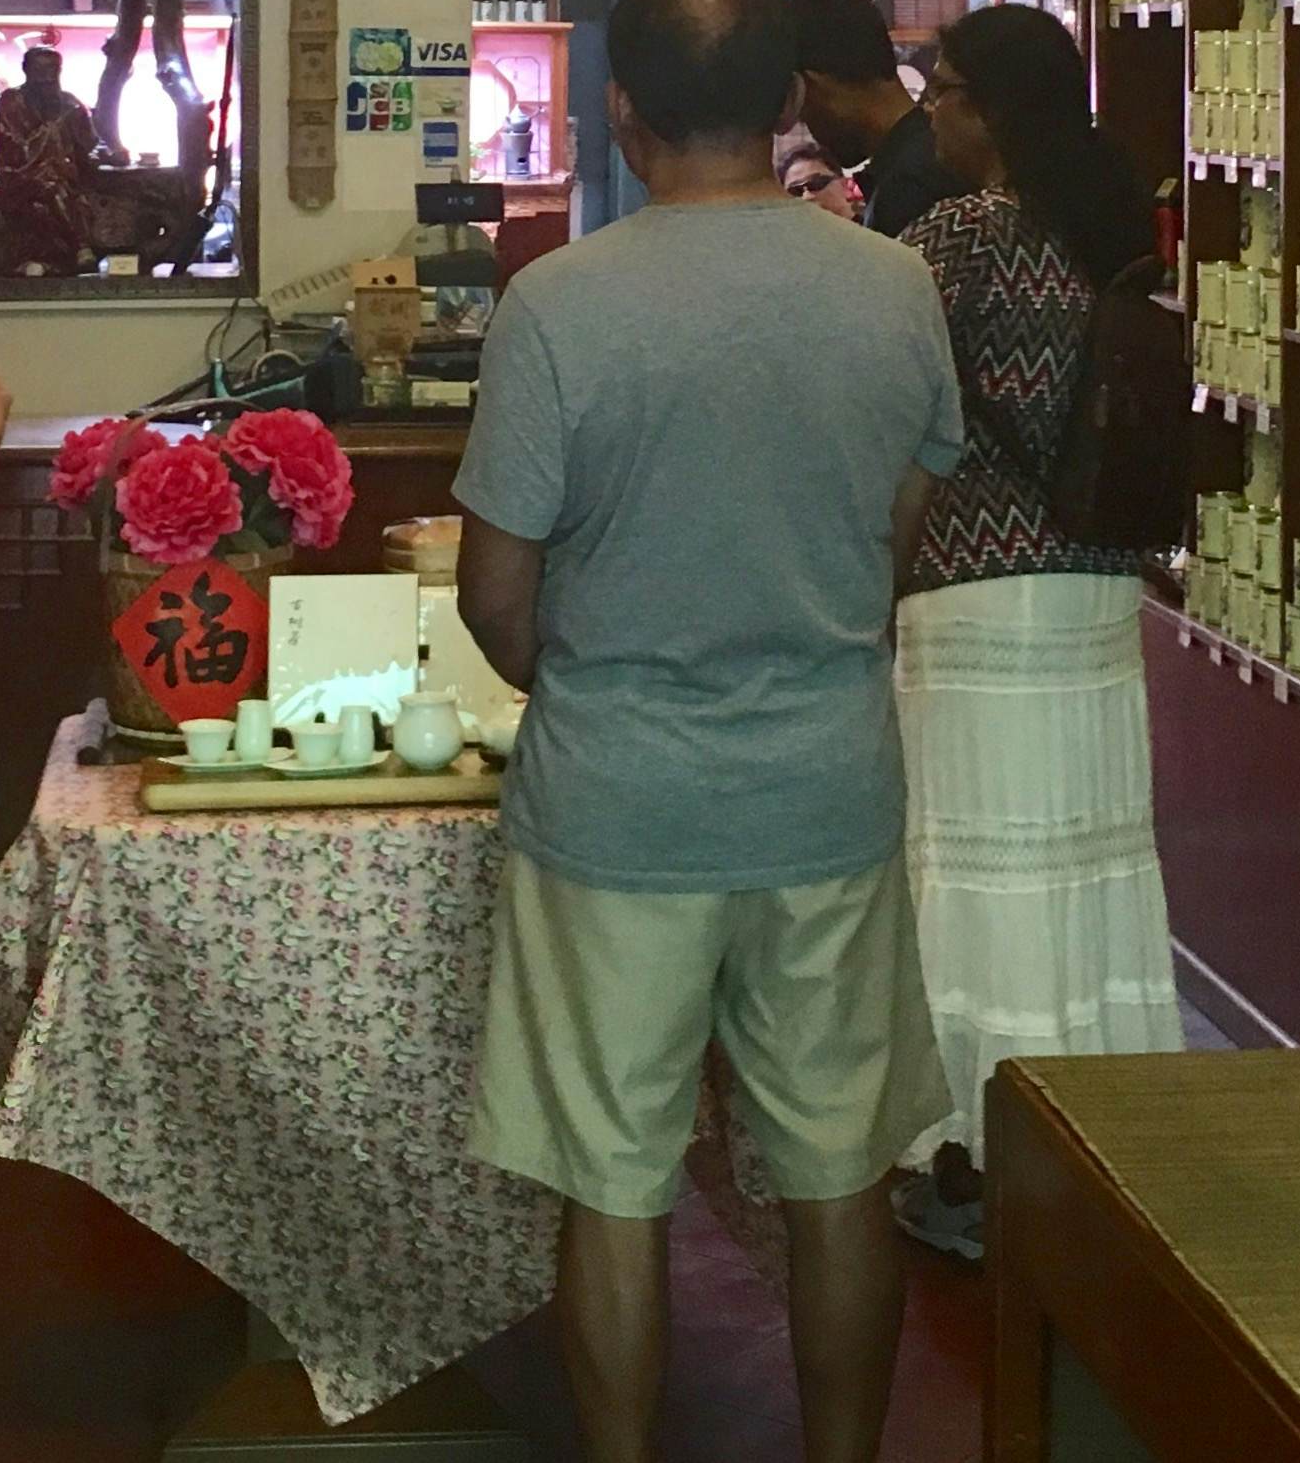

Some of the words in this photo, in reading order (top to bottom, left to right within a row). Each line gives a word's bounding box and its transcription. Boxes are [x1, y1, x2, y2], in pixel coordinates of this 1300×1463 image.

[417, 42, 468, 62] VISA
[346, 81, 413, 132] JCB
[143, 570, 250, 689] 福
